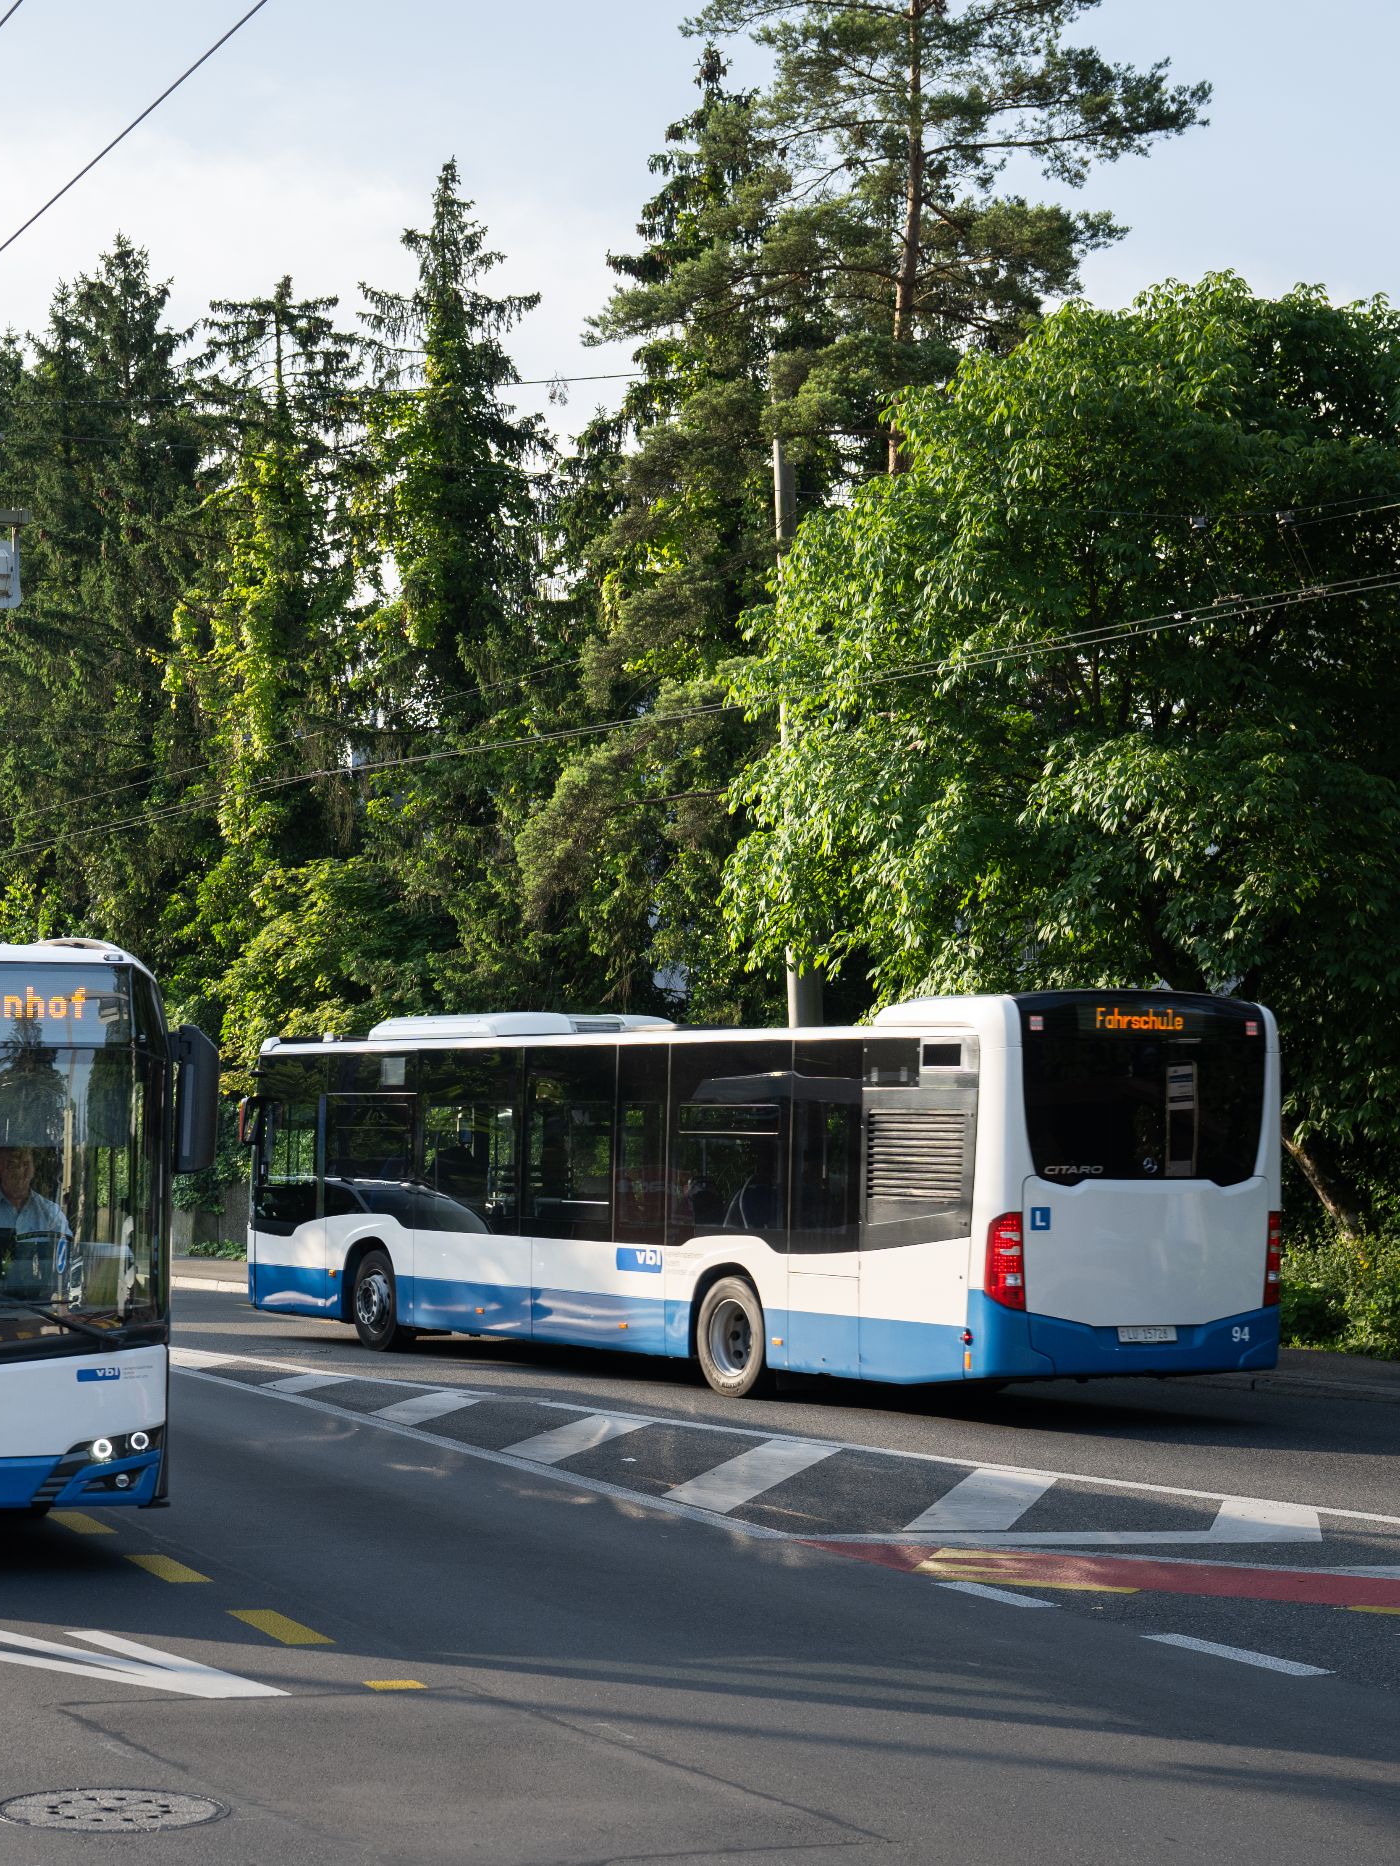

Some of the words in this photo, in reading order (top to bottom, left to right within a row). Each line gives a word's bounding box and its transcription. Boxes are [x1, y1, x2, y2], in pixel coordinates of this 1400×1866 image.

[1095, 1007, 1184, 1030] Fahrschule
[1044, 1165, 1104, 1175] CITARO
[1035, 1210, 1047, 1226] L
[635, 1248, 661, 1265] vbl
[1232, 1327, 1249, 1341] 94
[96, 1367, 119, 1377] vbl
